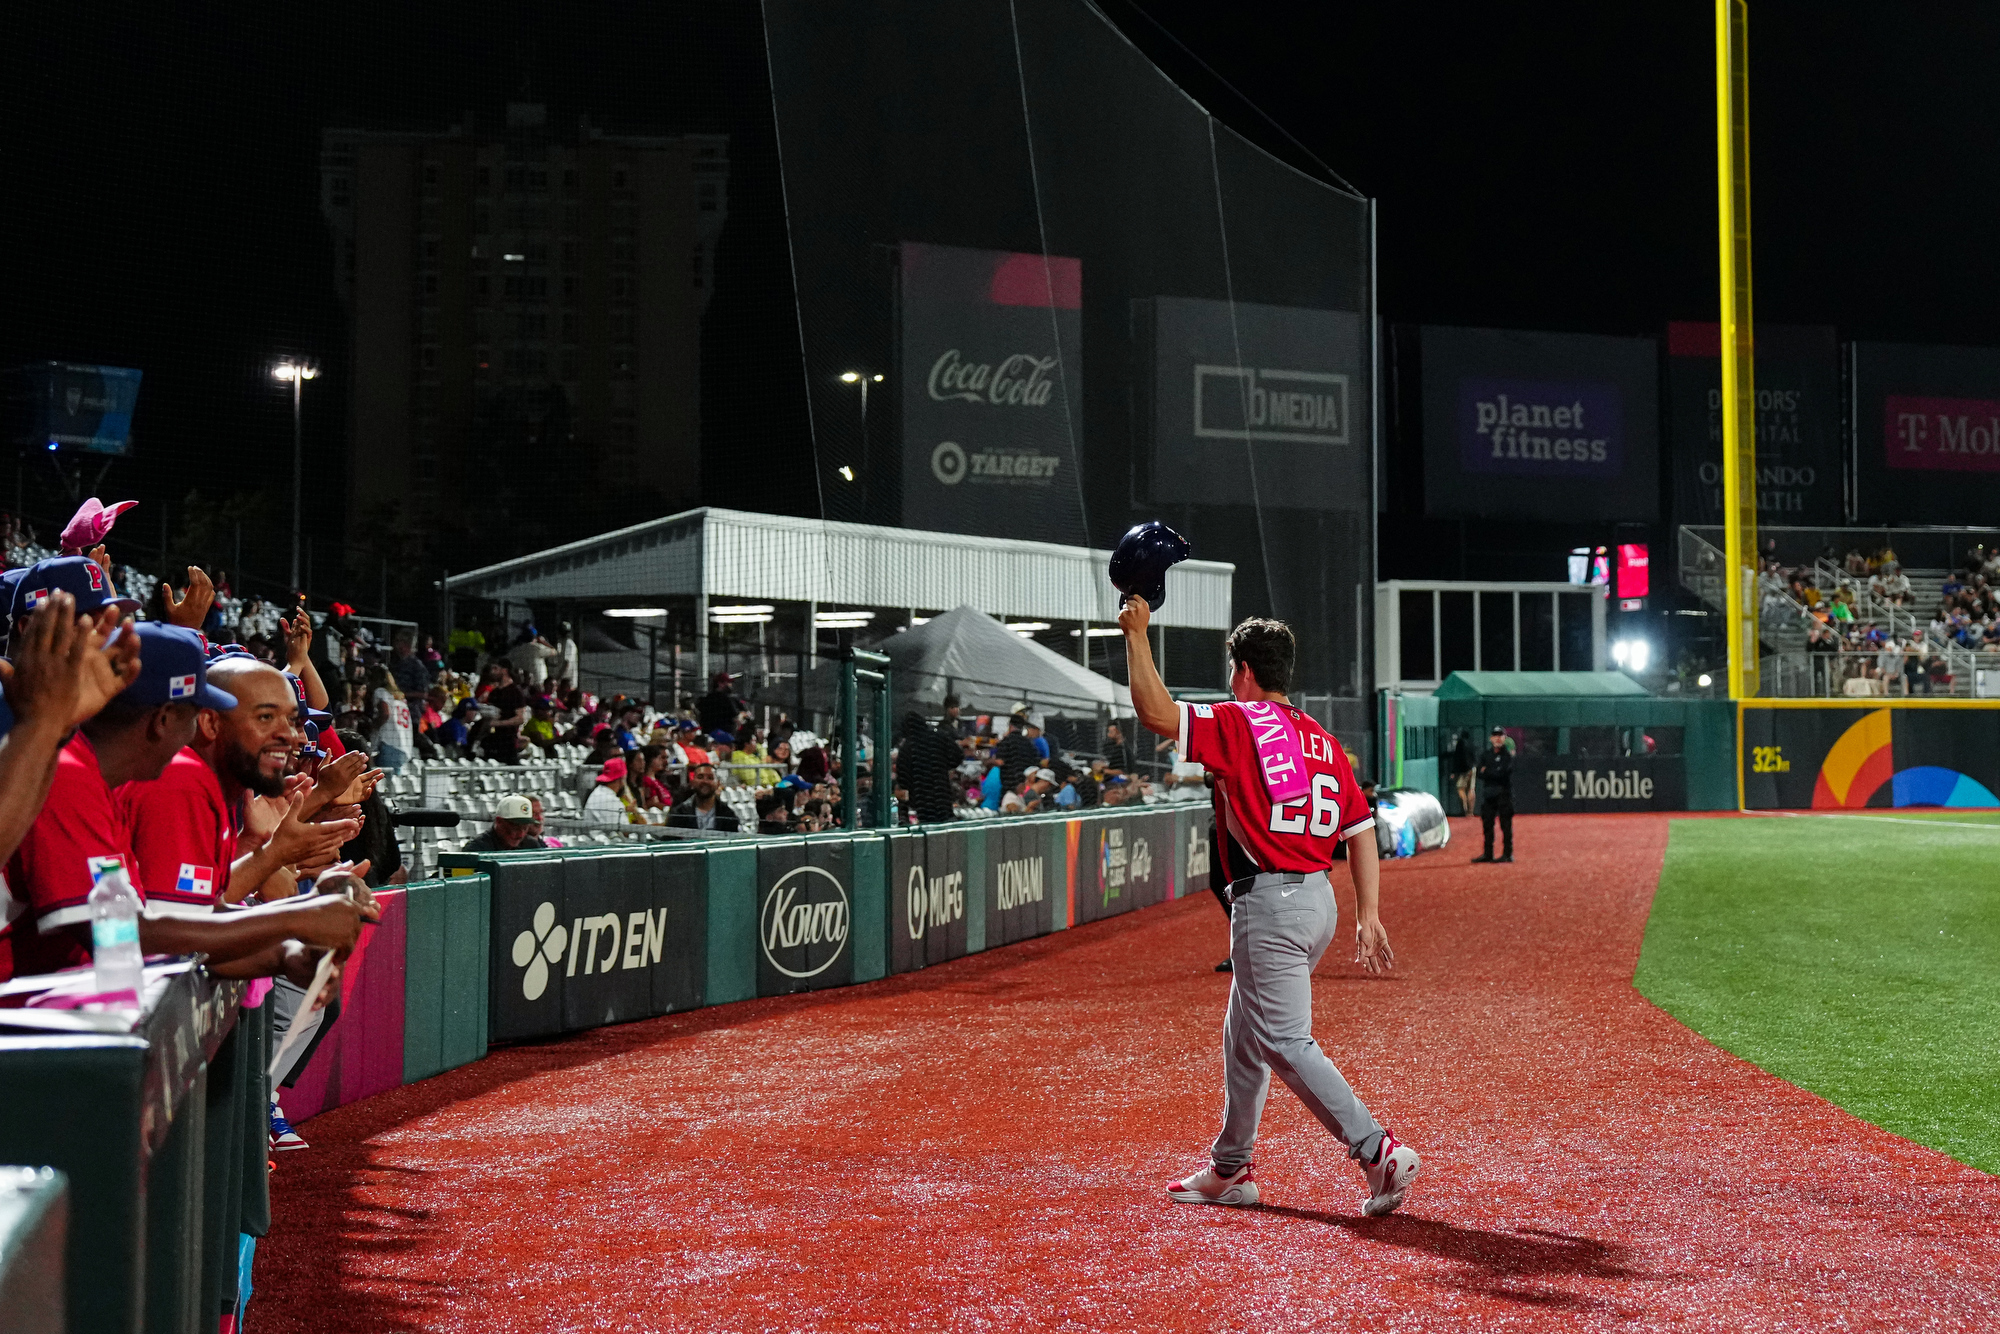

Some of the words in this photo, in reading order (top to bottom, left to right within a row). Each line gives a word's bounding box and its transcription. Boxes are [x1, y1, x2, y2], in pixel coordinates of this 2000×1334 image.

[1476, 394, 1585, 434] planet
[1491, 426, 1608, 463] fitness
[970, 452, 1060, 478] TARGET
[84, 562, 102, 592] P
[1299, 730, 1334, 765] LEN
[1573, 769, 1654, 800] Mobile
[1269, 772, 1341, 839] 26
[929, 870, 963, 928] MUFG
[997, 856, 1043, 910] KONAMI
[768, 887, 846, 951] Kowa
